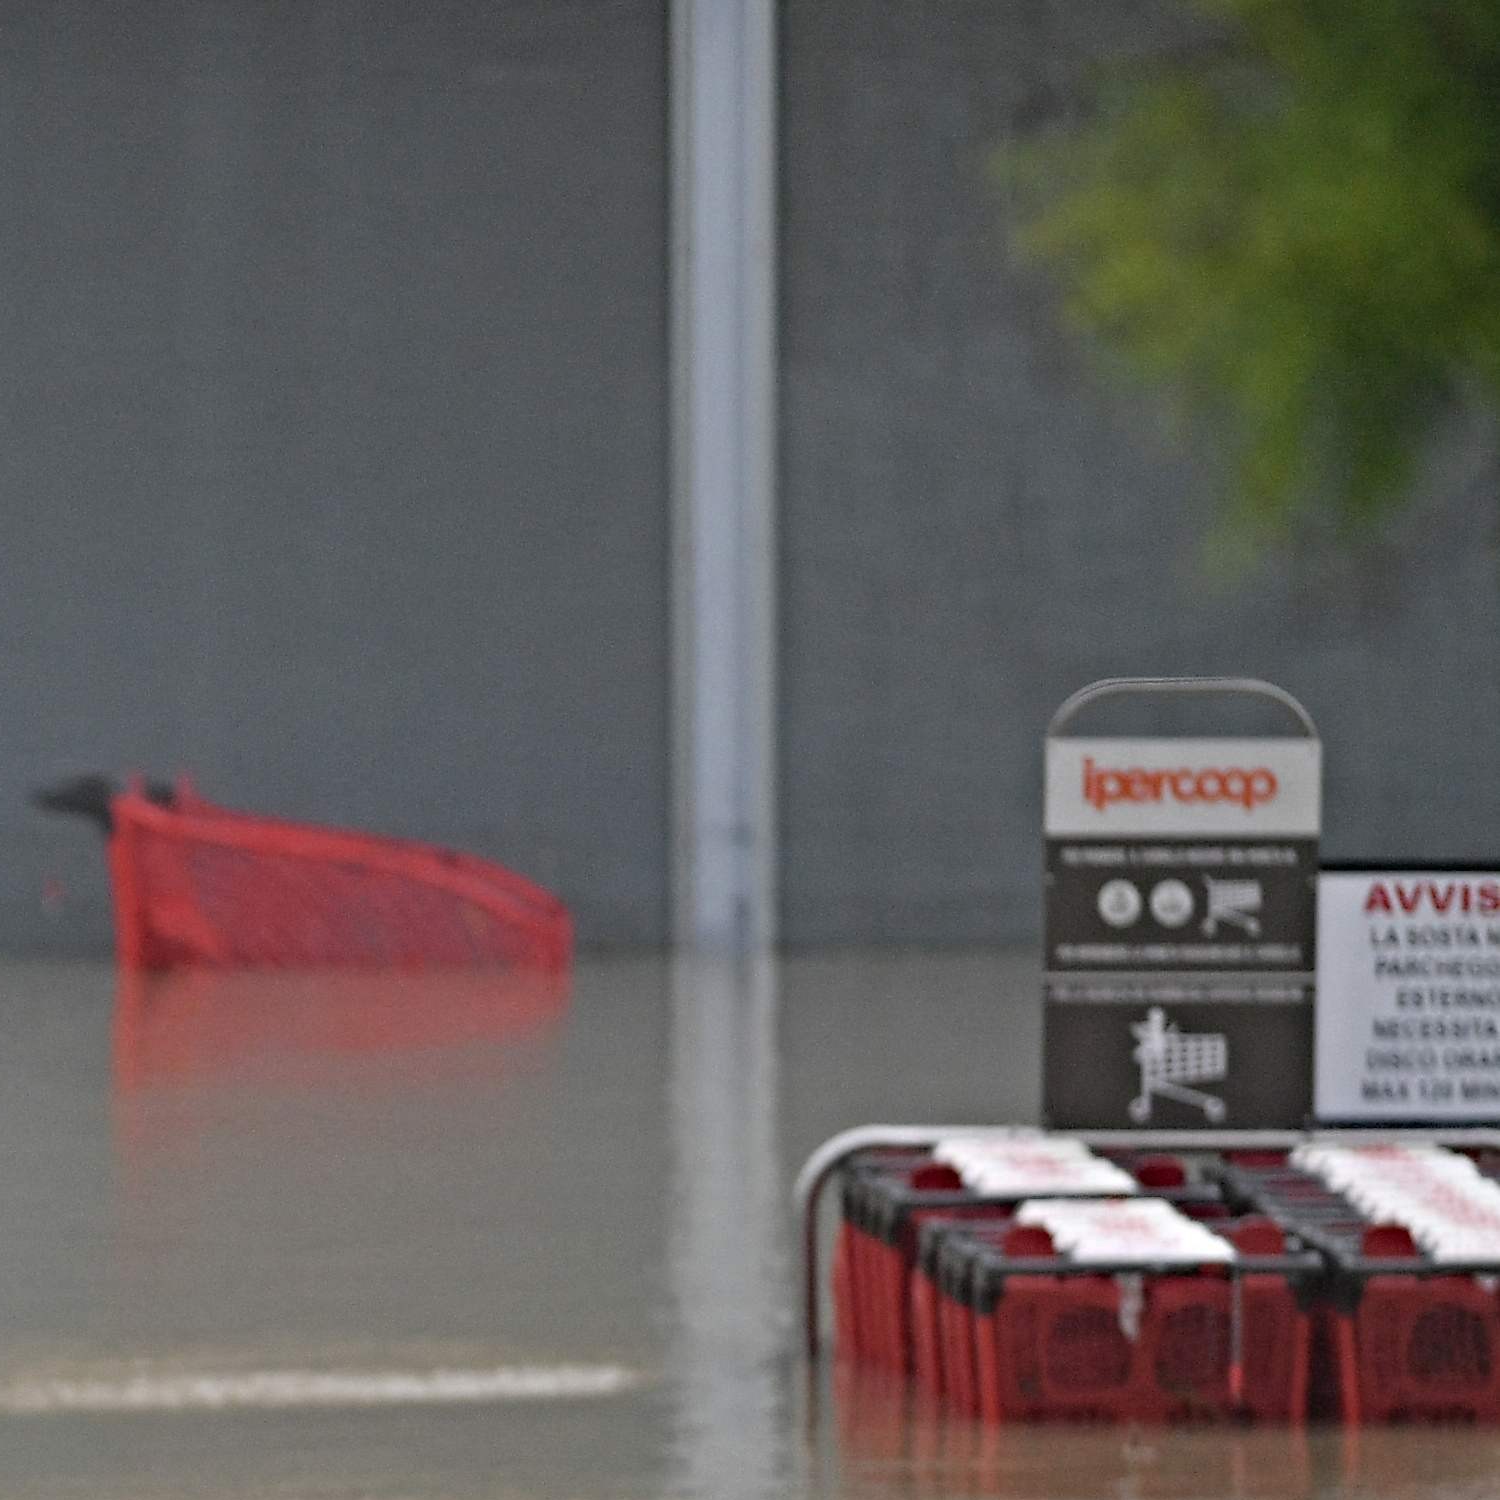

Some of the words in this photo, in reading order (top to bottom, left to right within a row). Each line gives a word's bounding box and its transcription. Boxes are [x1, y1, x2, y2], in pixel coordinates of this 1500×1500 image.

[1082, 755, 1278, 813] ipercoop
[1370, 926, 1399, 946] LA
[1406, 925, 1481, 946] SOSTA
